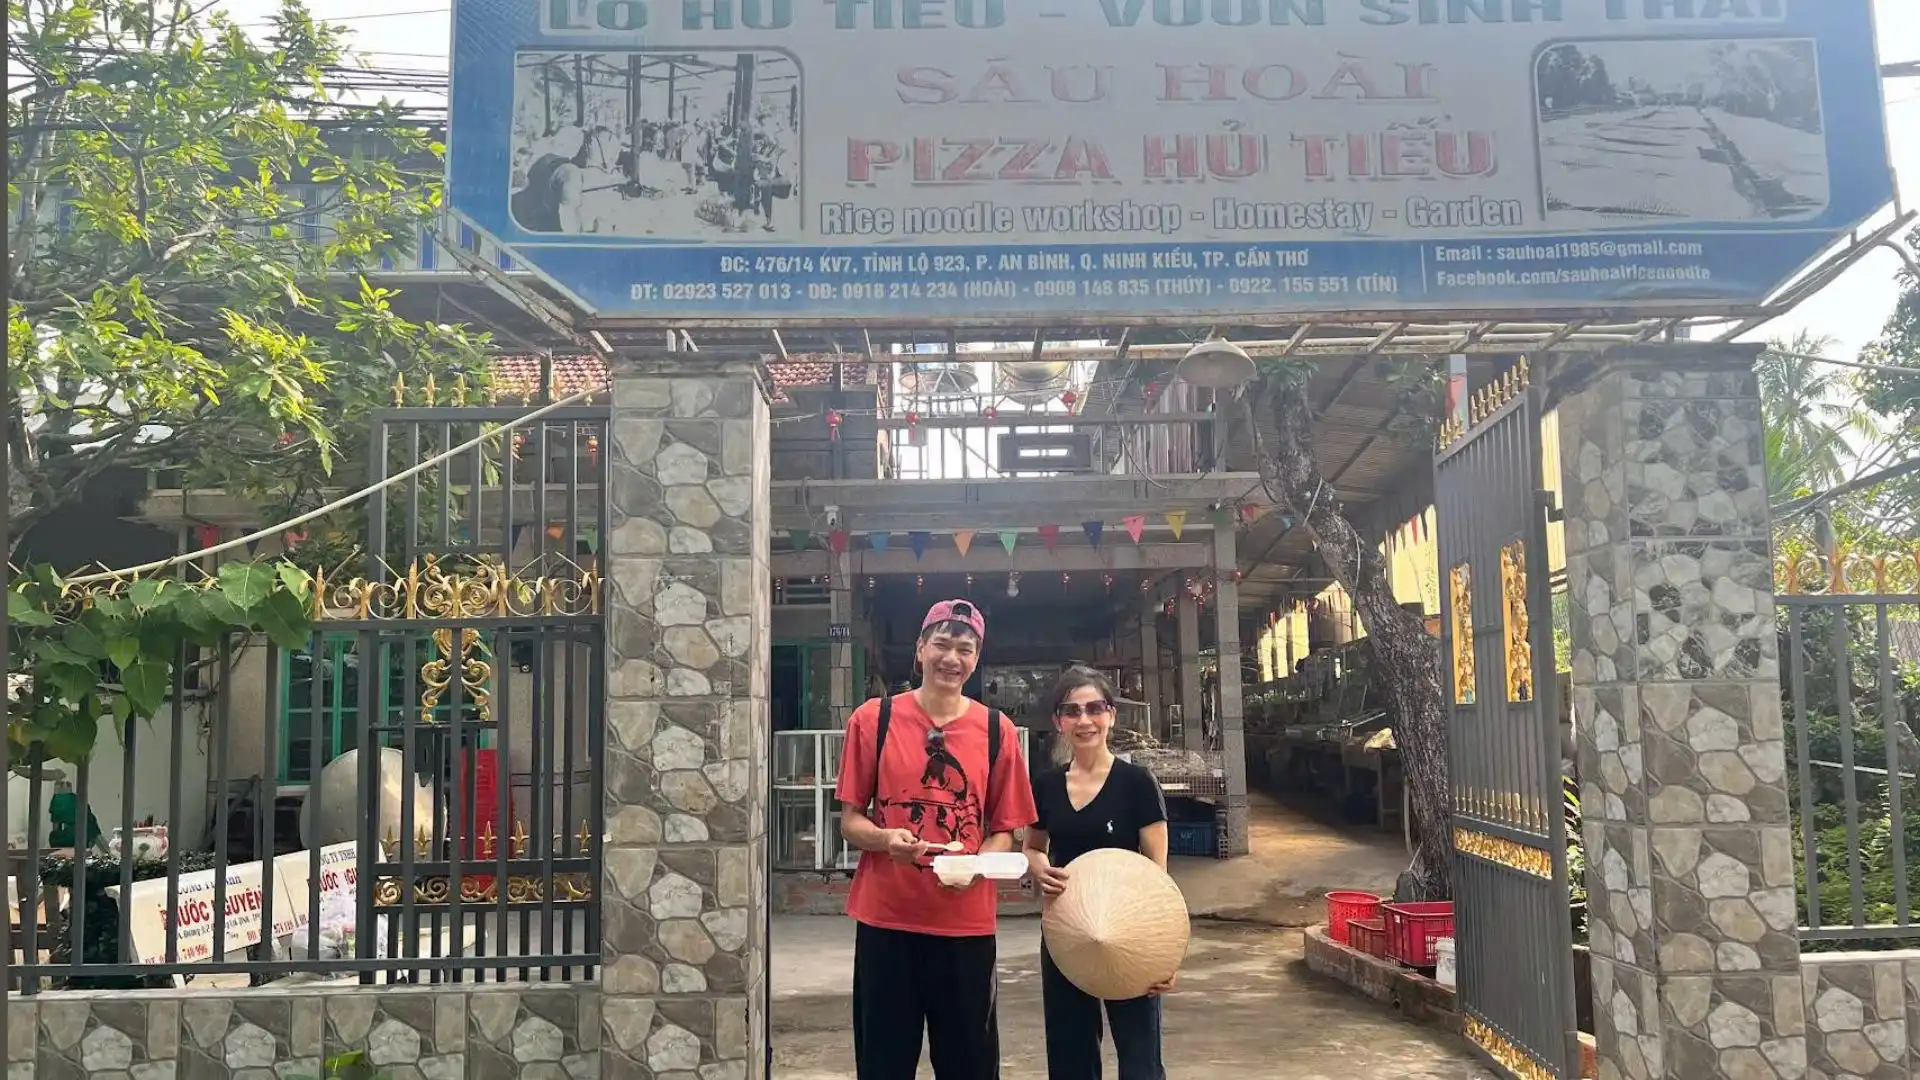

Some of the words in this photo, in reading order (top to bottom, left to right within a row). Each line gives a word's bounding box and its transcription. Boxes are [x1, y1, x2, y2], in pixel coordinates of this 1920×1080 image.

[1359, 0, 1563, 24] SINH
[1155, 51, 1441, 103] HOÀI
[846, 135, 1119, 185] PIZZA
[1142, 119, 1265, 181] HỦ
[820, 202, 895, 235] Rice
[903, 201, 1014, 234] noodle
[1022, 200, 1181, 234] workshop
[1191, 211, 1204, 221] -
[1213, 197, 1373, 231] Homestay
[1383, 209, 1397, 219] -
[1406, 194, 1522, 228] Garden
[720, 256, 749, 273] ĐC:
[755, 255, 814, 273] 476/14
[820, 255, 857, 274] KV7,
[908, 252, 929, 276] LỘ
[934, 254, 970, 273] 923,
[976, 254, 992, 271] P.
[998, 253, 1023, 271] AN
[1027, 252, 1075, 272] BÌNH,
[1080, 252, 1097, 270] Q.
[1103, 251, 1147, 269] NINH
[1202, 250, 1229, 269] TP.
[1435, 246, 1482, 262] Email
[1487, 249, 1492, 260] :
[630, 283, 657, 300] ĐT:
[663, 283, 717, 300] 02923
[722, 283, 752, 300] 527
[759, 282, 791, 299] 013
[842, 282, 884, 299] 0918
[889, 281, 922, 299] 214
[927, 281, 957, 298] 234
[1083, 279, 1113, 296] 148
[1118, 278, 1149, 295] 835
[1282, 277, 1313, 293] 155
[1319, 276, 1349, 293] 551
